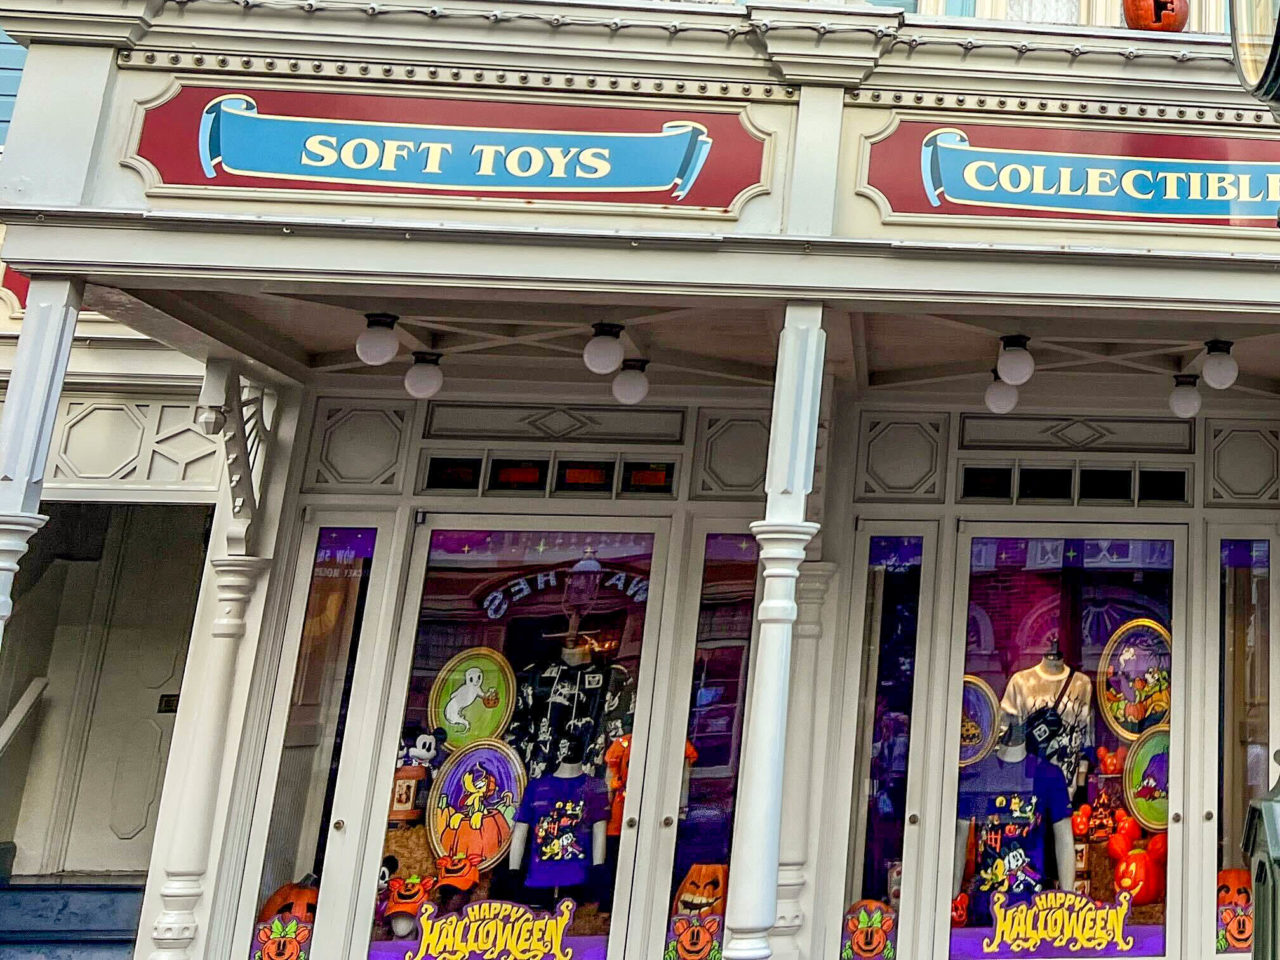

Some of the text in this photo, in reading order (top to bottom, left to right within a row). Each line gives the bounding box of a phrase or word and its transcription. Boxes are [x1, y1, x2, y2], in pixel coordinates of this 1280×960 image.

[301, 134, 612, 179] SOFT TOYS
[467, 902, 526, 922] HAPPY
[983, 892, 1134, 953] HALLOWEEN
[1035, 892, 1089, 911] HAPPY
[405, 900, 573, 960] HALLOWEEN
